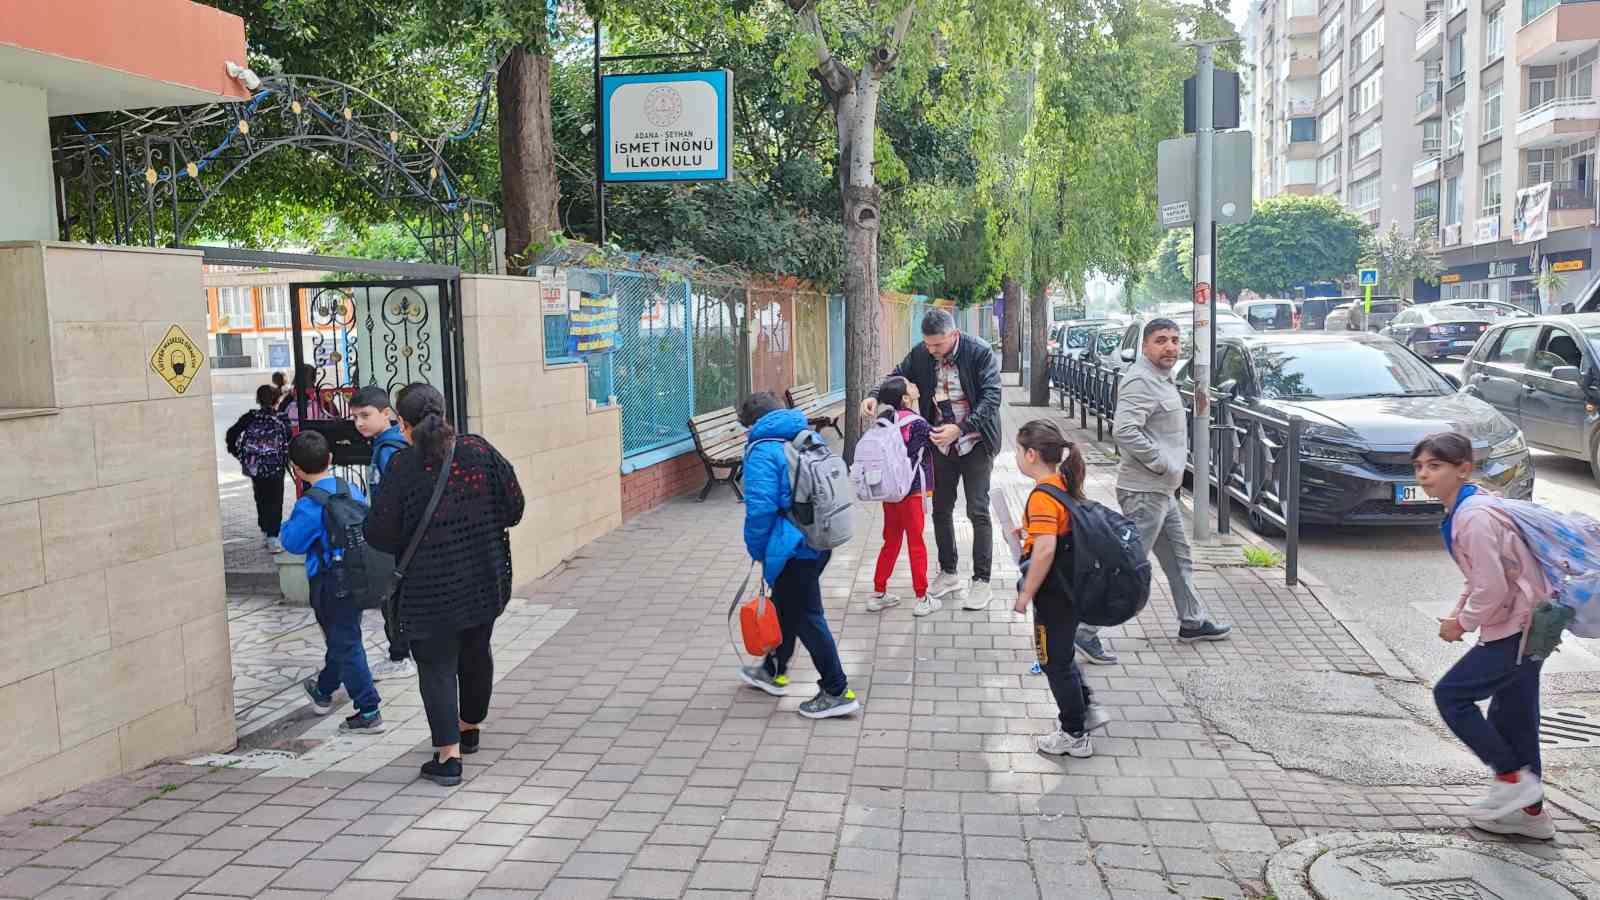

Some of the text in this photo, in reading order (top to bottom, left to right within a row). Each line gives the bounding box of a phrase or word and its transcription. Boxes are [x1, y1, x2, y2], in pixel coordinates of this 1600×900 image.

[635, 131, 659, 139] ADANA
[615, 136, 713, 154] İSMET İNÖNÜ
[626, 154, 702, 168] İLKOKULU
[1403, 486, 1416, 500] 01
